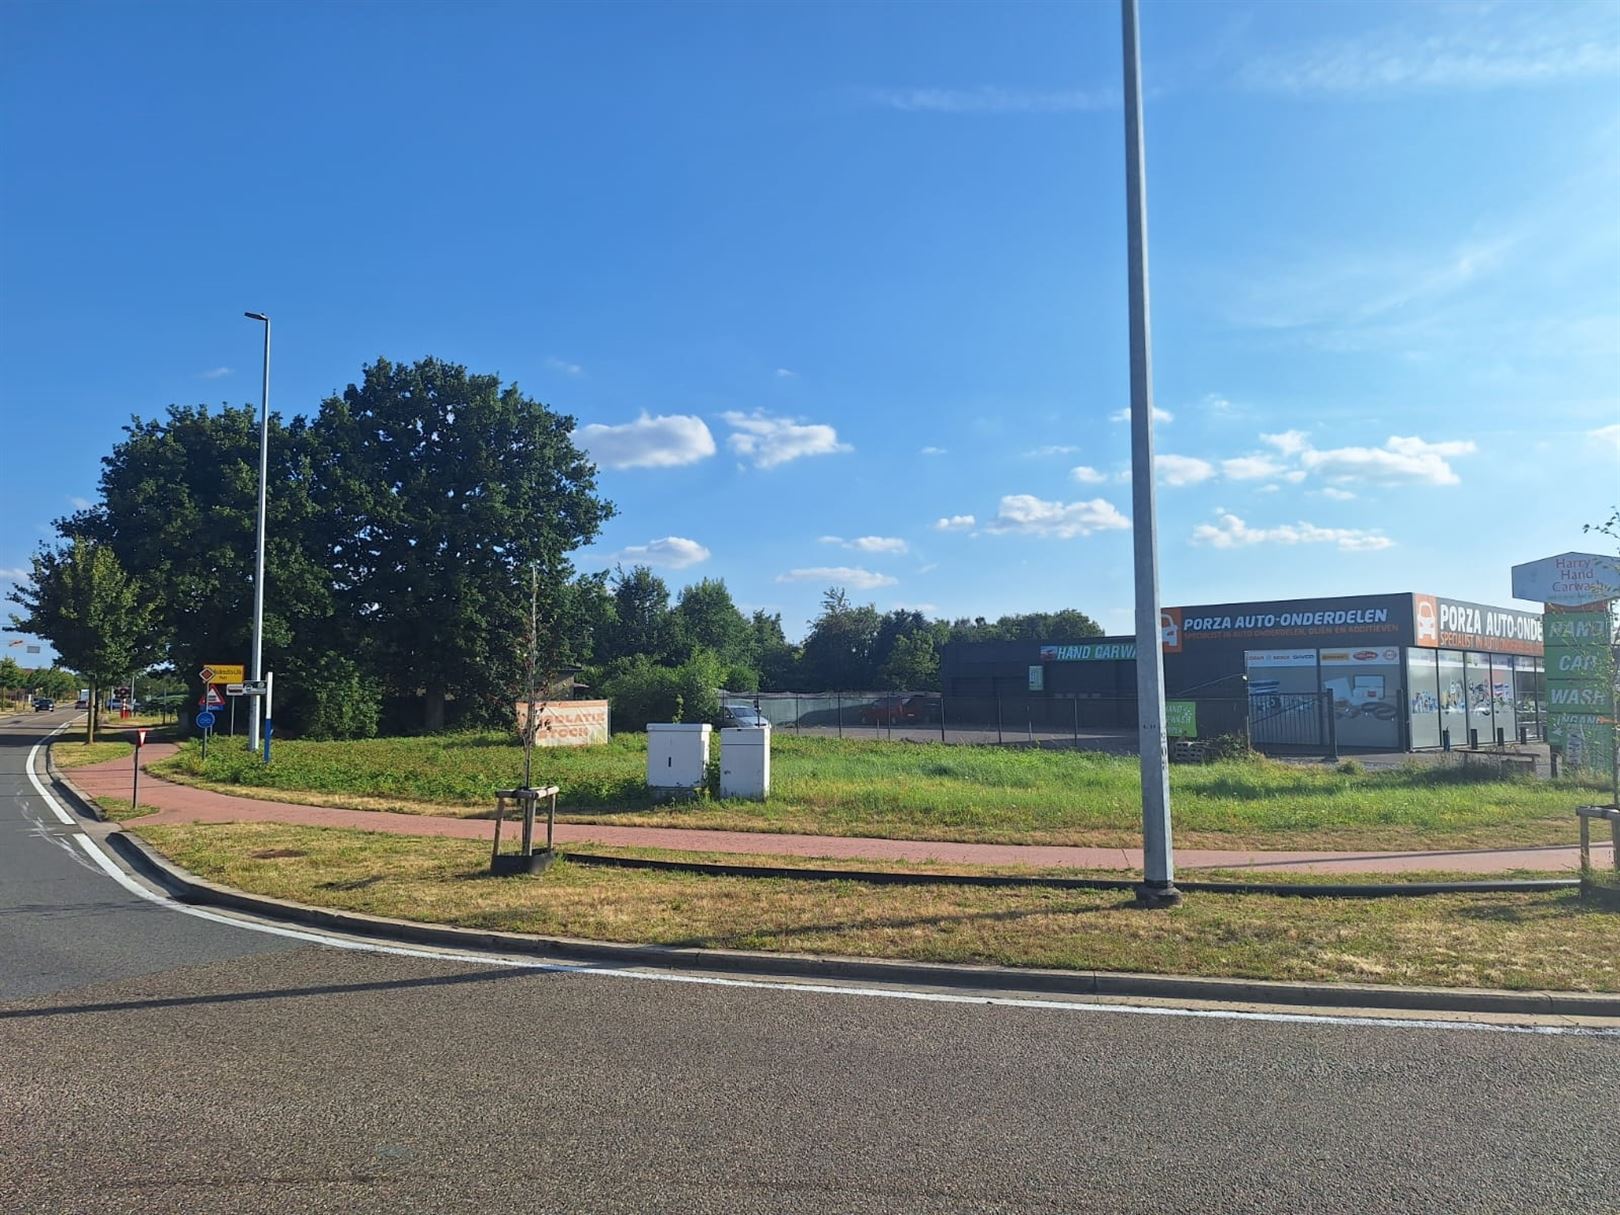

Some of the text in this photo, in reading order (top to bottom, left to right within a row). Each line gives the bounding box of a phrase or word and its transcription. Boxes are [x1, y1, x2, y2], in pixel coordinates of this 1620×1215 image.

[1556, 559, 1590, 569] Harry
[1561, 569, 1593, 580] Hand
[1184, 608, 1388, 631] PORZA AUTO-ONDERDELEN
[1440, 604, 1482, 635] PORZA
[1057, 646, 1091, 659] HAND
